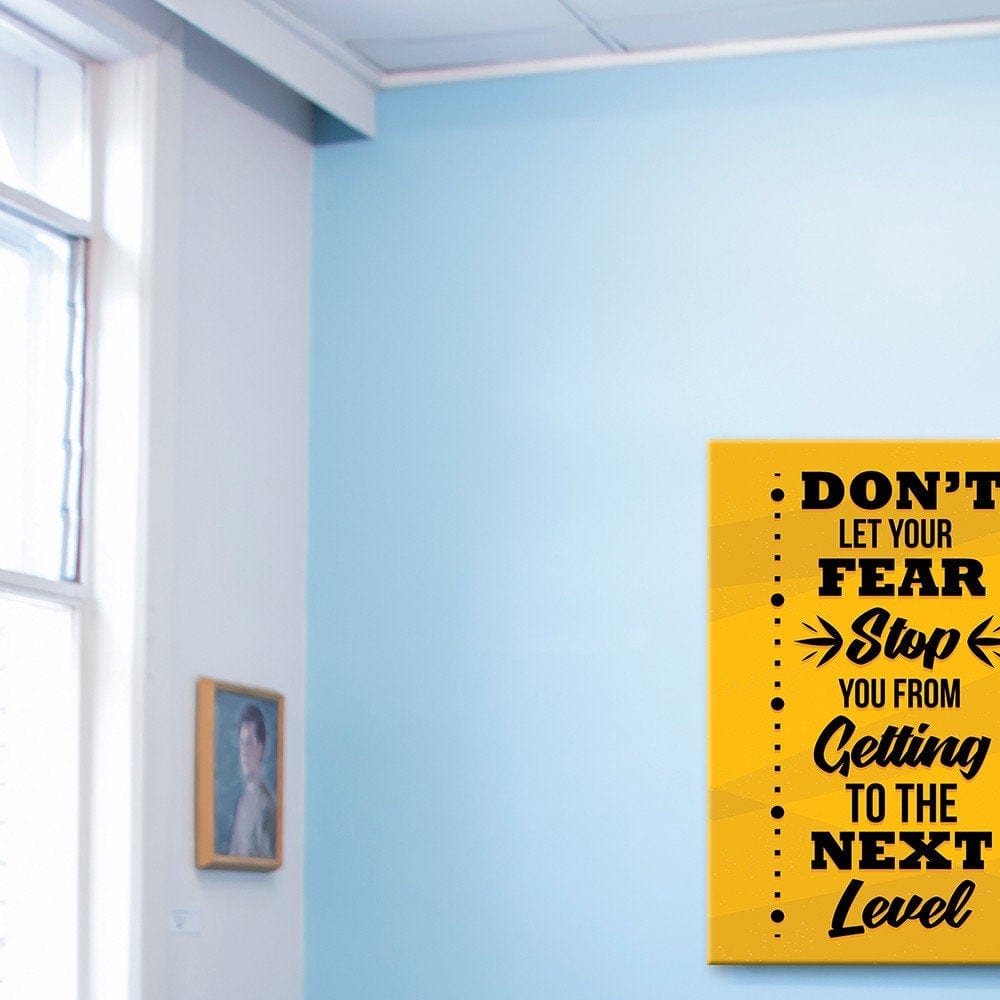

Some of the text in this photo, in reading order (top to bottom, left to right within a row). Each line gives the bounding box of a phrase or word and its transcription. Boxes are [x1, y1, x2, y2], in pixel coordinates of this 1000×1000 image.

[839, 519, 952, 548] LET YOUR
[818, 558, 987, 597] FEAR
[845, 607, 961, 670] Stop
[838, 678, 961, 708] YOU FROM
[812, 715, 992, 780] Getting
[846, 783, 958, 823] TO THE
[811, 831, 993, 870] NEXT
[829, 879, 977, 939] Level
